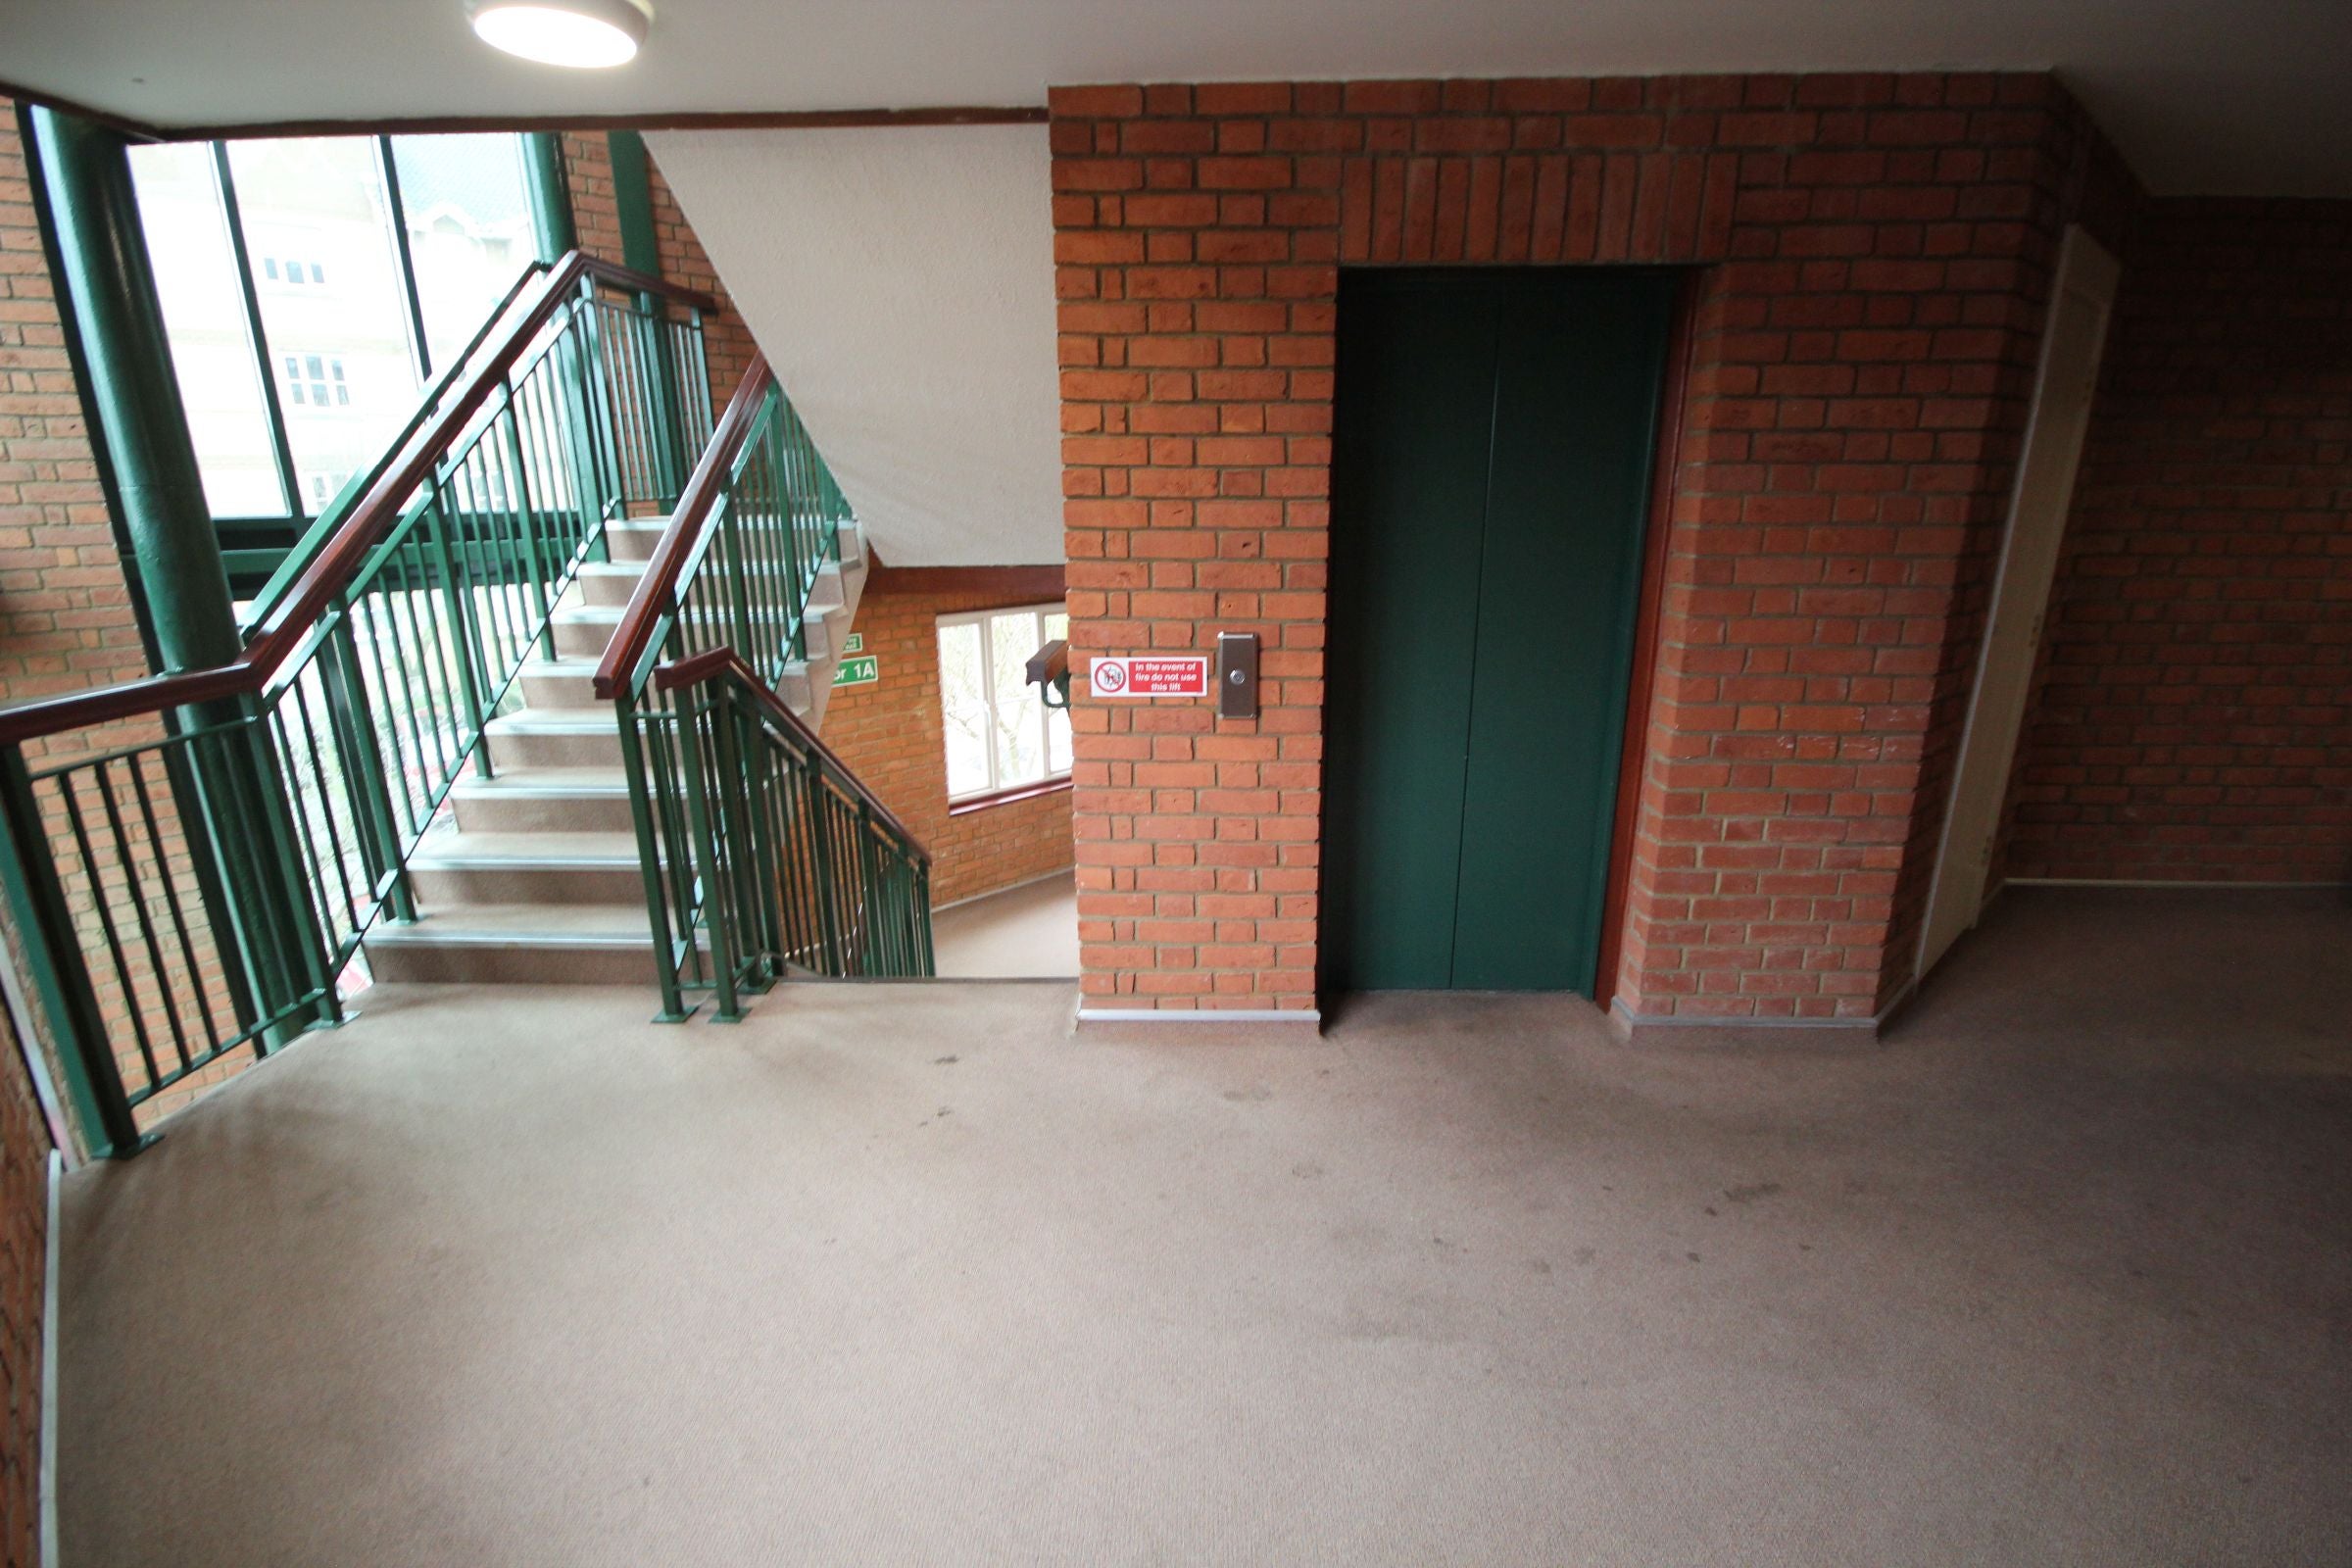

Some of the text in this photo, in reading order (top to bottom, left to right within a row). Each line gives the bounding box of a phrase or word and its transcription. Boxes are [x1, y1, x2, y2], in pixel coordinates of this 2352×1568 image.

[854, 662, 875, 678] 1A
[1135, 662, 1145, 671] In
[1146, 662, 1160, 671] the
[1187, 662, 1197, 671] of
